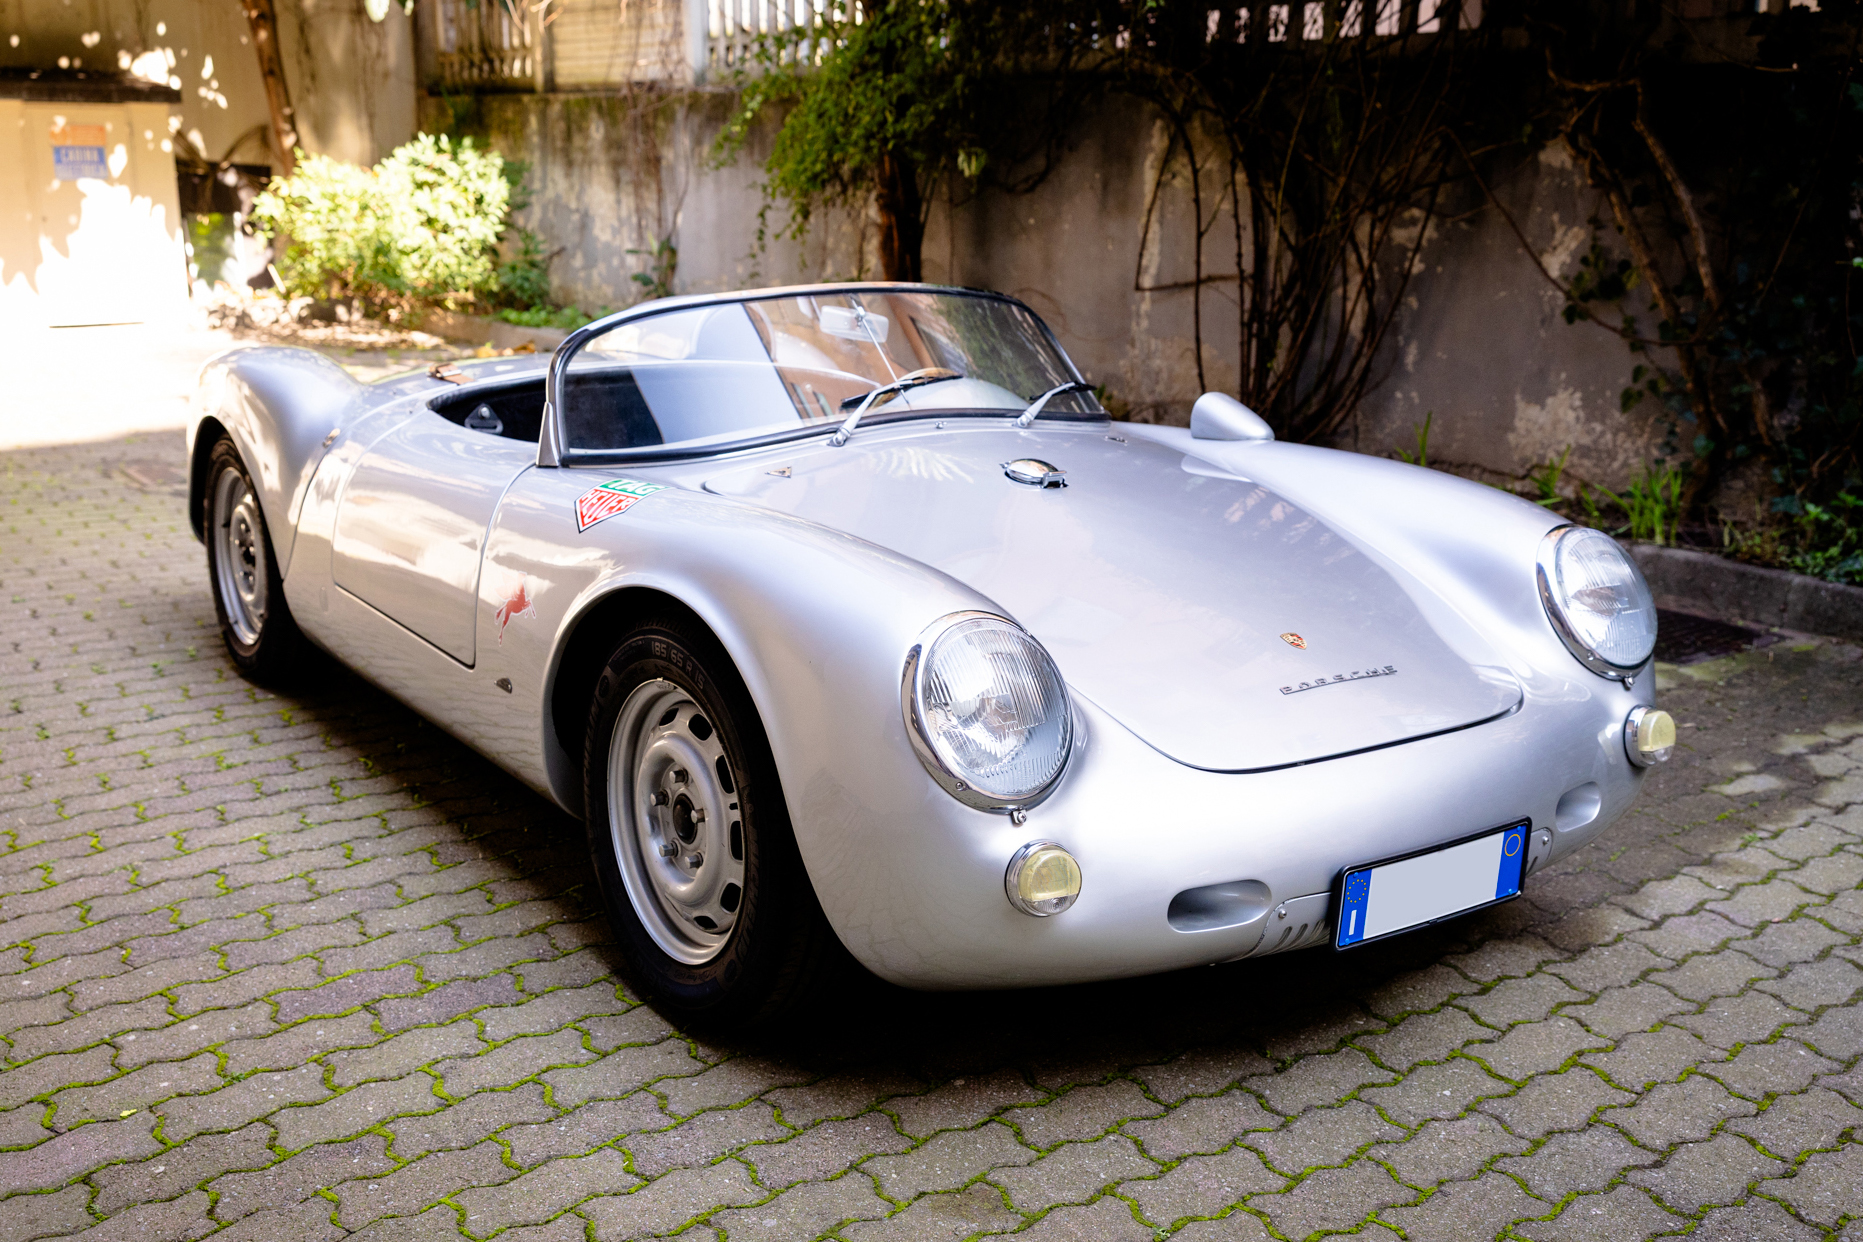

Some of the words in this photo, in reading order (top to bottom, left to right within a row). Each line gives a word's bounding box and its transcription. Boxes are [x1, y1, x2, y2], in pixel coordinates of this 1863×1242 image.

[607, 479, 665, 496] TAG
[580, 488, 638, 526] HEUER
[685, 660, 693, 677] R
[1279, 665, 1396, 695] PORSCHE
